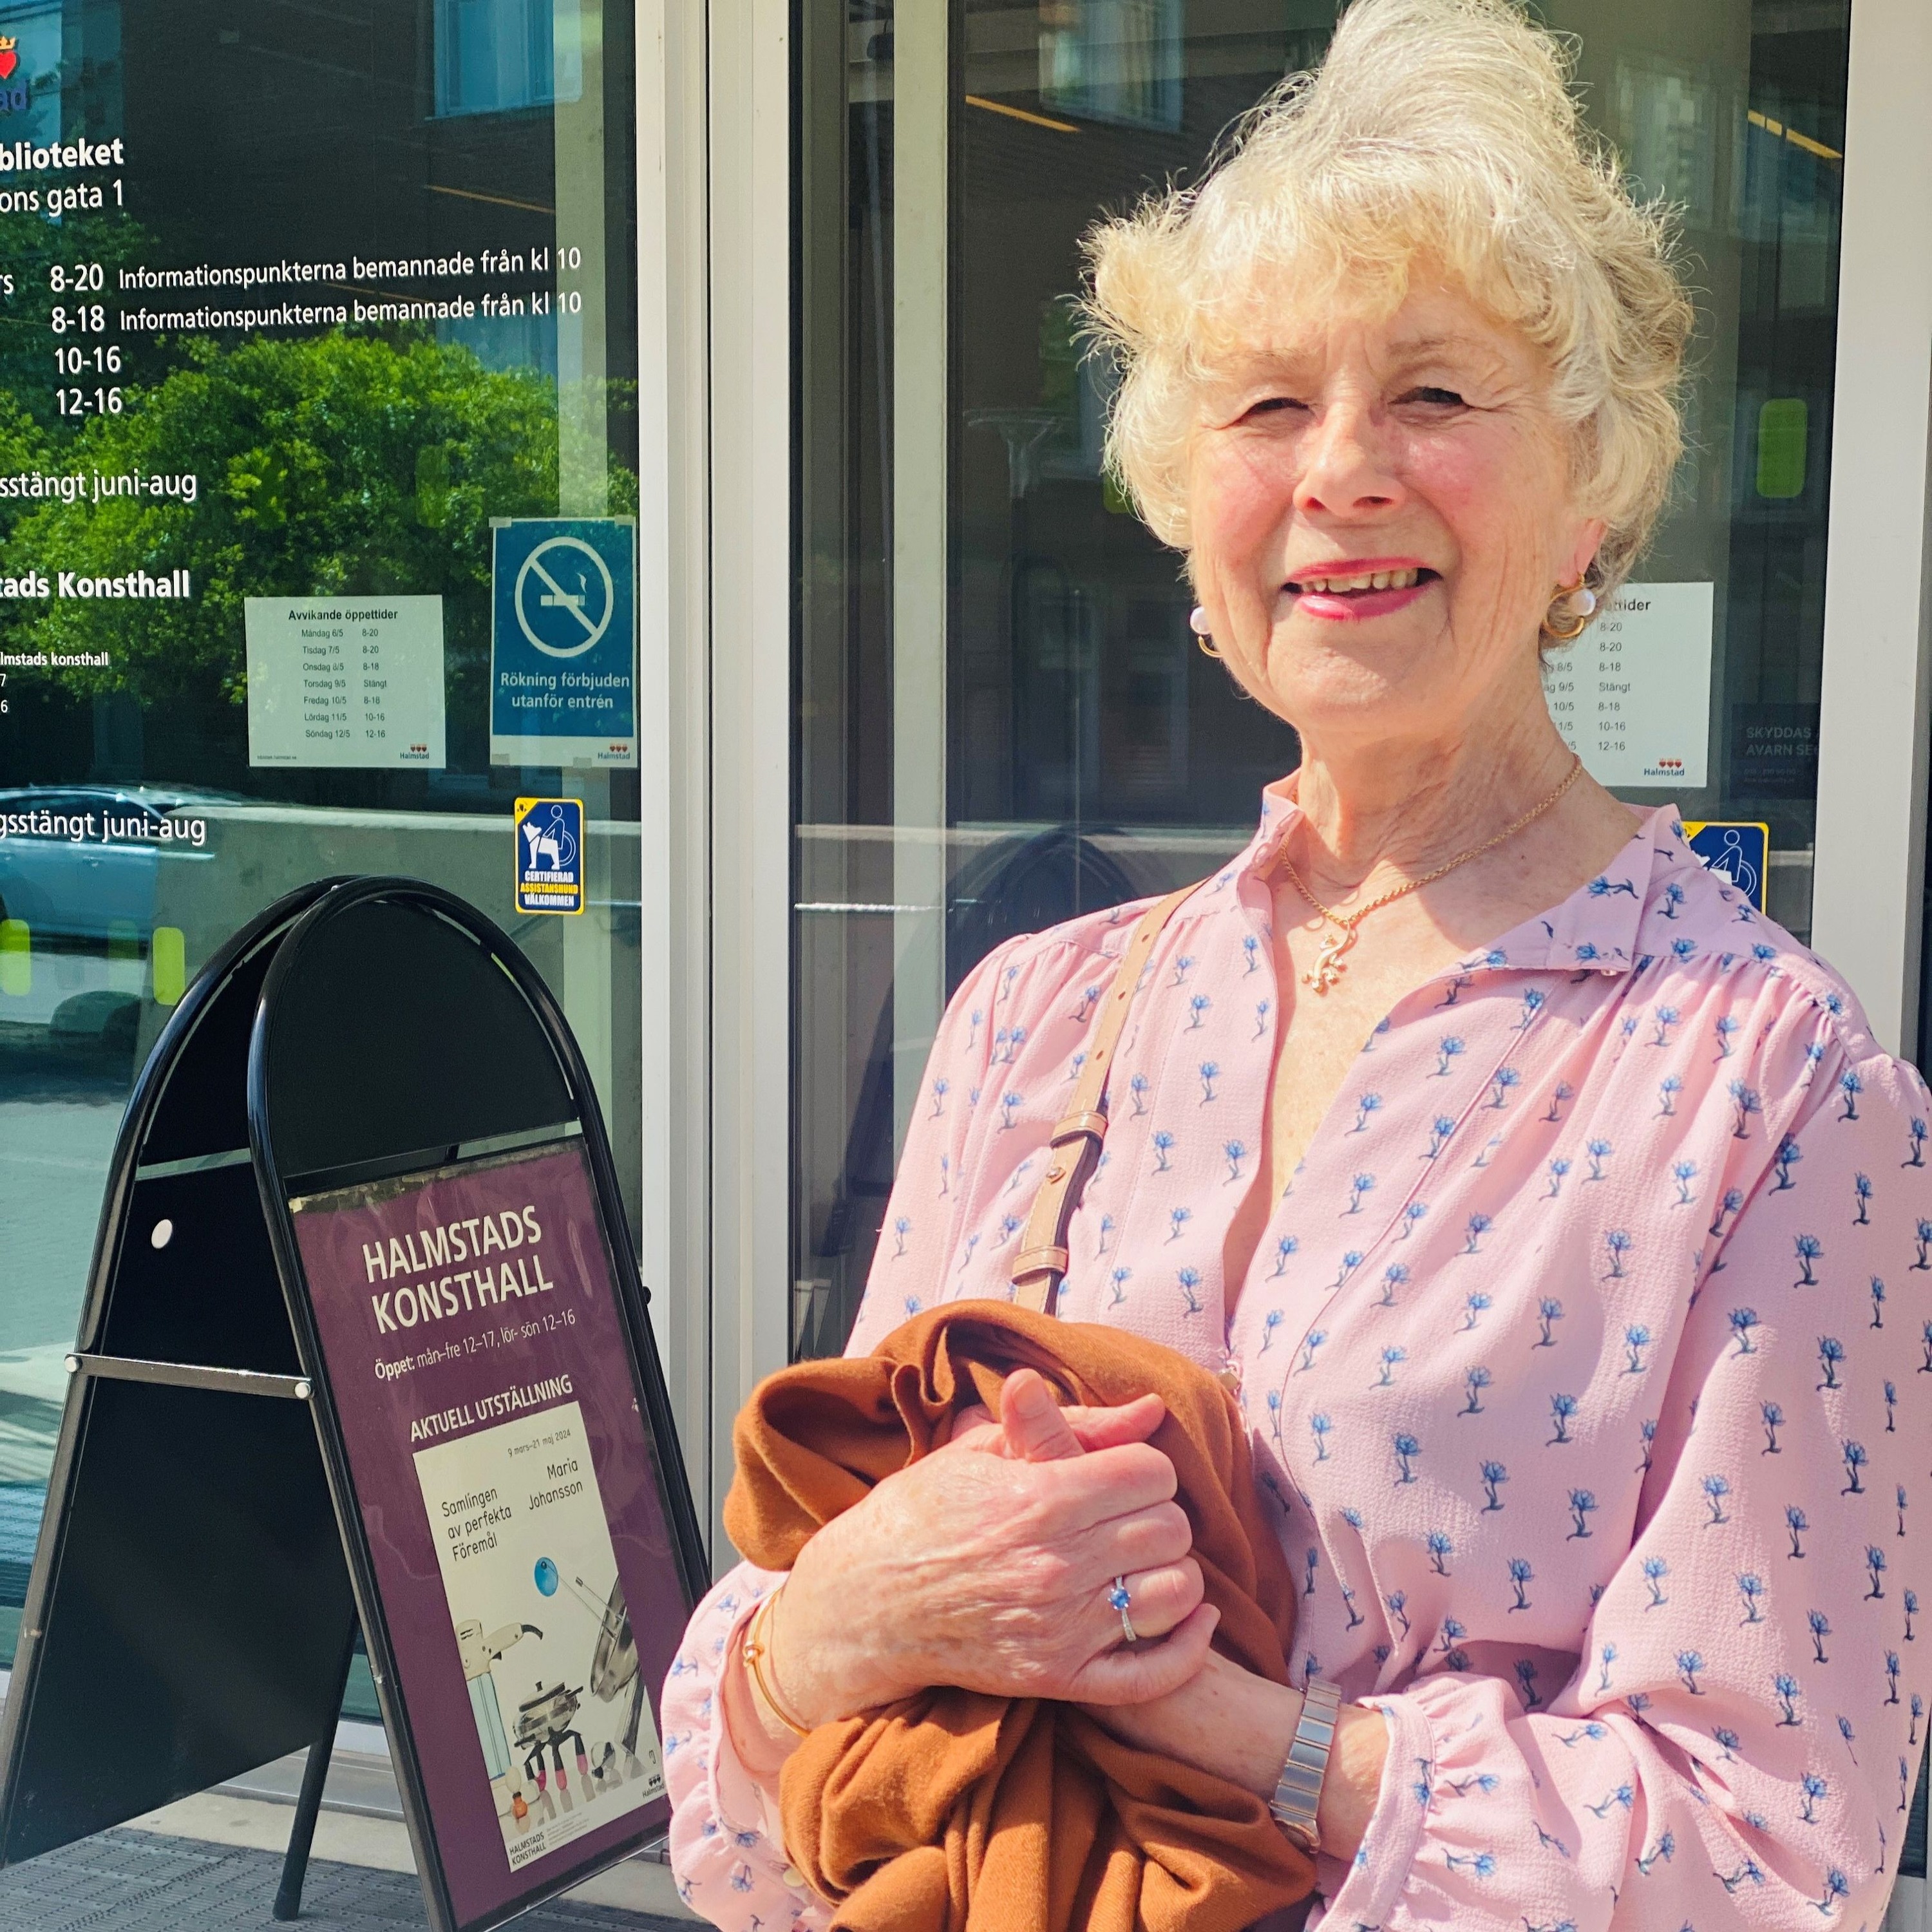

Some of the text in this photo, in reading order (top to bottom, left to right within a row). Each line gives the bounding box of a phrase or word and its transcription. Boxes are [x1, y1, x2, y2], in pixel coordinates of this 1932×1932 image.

[0, 138, 124, 171] blioteket
[0, 178, 122, 218] ons gata 1
[50, 263, 104, 292] 8-20
[119, 260, 346, 290] Informationspunkterna
[353, 252, 474, 279] bemannade
[480, 249, 524, 274] från
[531, 247, 548, 271] kl
[558, 247, 581, 269] 10
[52, 291, 581, 334] 8-18 Informationspunkterna bemannade från kl 10
[55, 346, 121, 374] 10-16
[56, 387, 122, 415] 12-16
[0, 468, 198, 503] sstängt juni-aug
[58, 569, 190, 598] Konsthall
[289, 609, 398, 622] Avvikande öppettider
[301, 628, 379, 639] Måndag 6/5 8-20
[1600, 622, 1622, 632] 8-20
[303, 645, 379, 656] Tisdag 7/5 8-20
[1600, 642, 1622, 652] 8-20
[51, 652, 109, 666] konsthall
[303, 663, 330, 672] Onsdag
[363, 662, 379, 670] 8-18
[1599, 662, 1621, 672] 8-18
[303, 679, 387, 689] Torsdag 9/5 Stängt
[500, 672, 630, 691] Rökning förbjuden
[1558, 682, 1574, 692] 9/5
[1599, 682, 1631, 694] Stängt
[303, 696, 380, 706] Fredag 10/5 8-18
[511, 693, 614, 709] utanför entrén
[1554, 701, 1620, 711] 10/5 8-18
[304, 713, 385, 723] Lördag 11/5 10-16
[1599, 721, 1626, 731] 10-16
[305, 730, 386, 739] Söndag 12/5 12-16
[1746, 726, 1812, 739] SKYDDAS
[1598, 741, 1625, 751] 12-16
[1746, 744, 1792, 756] AVARN
[1643, 768, 1685, 777] Halmstad
[102, 810, 207, 846] juni-aug
[525, 871, 574, 883] CERTIFIERAD
[520, 883, 579, 894] ASSISTANSHUND
[524, 893, 574, 906] VÄLKOMMEN
[362, 1205, 542, 1283] HALMSTADS
[371, 1255, 554, 1334] KONSTHALL
[374, 1355, 415, 1381] Öppet:
[520, 1321, 540, 1338] sön
[410, 1374, 573, 1443] AKTUELL UTSTÄLLNING
[507, 1448, 513, 1457] 9
[542, 1434, 554, 1444] maj
[555, 1428, 571, 1441] 2024
[547, 1457, 578, 1480] Maria
[441, 1488, 498, 1517] Samlingen
[529, 1481, 583, 1510] Johansson
[448, 1506, 512, 1539] av perfekta
[452, 1531, 498, 1562] Föremål
[509, 1832, 544, 1856] HALMSTADS
[511, 1842, 547, 1866] KONSTHALL
